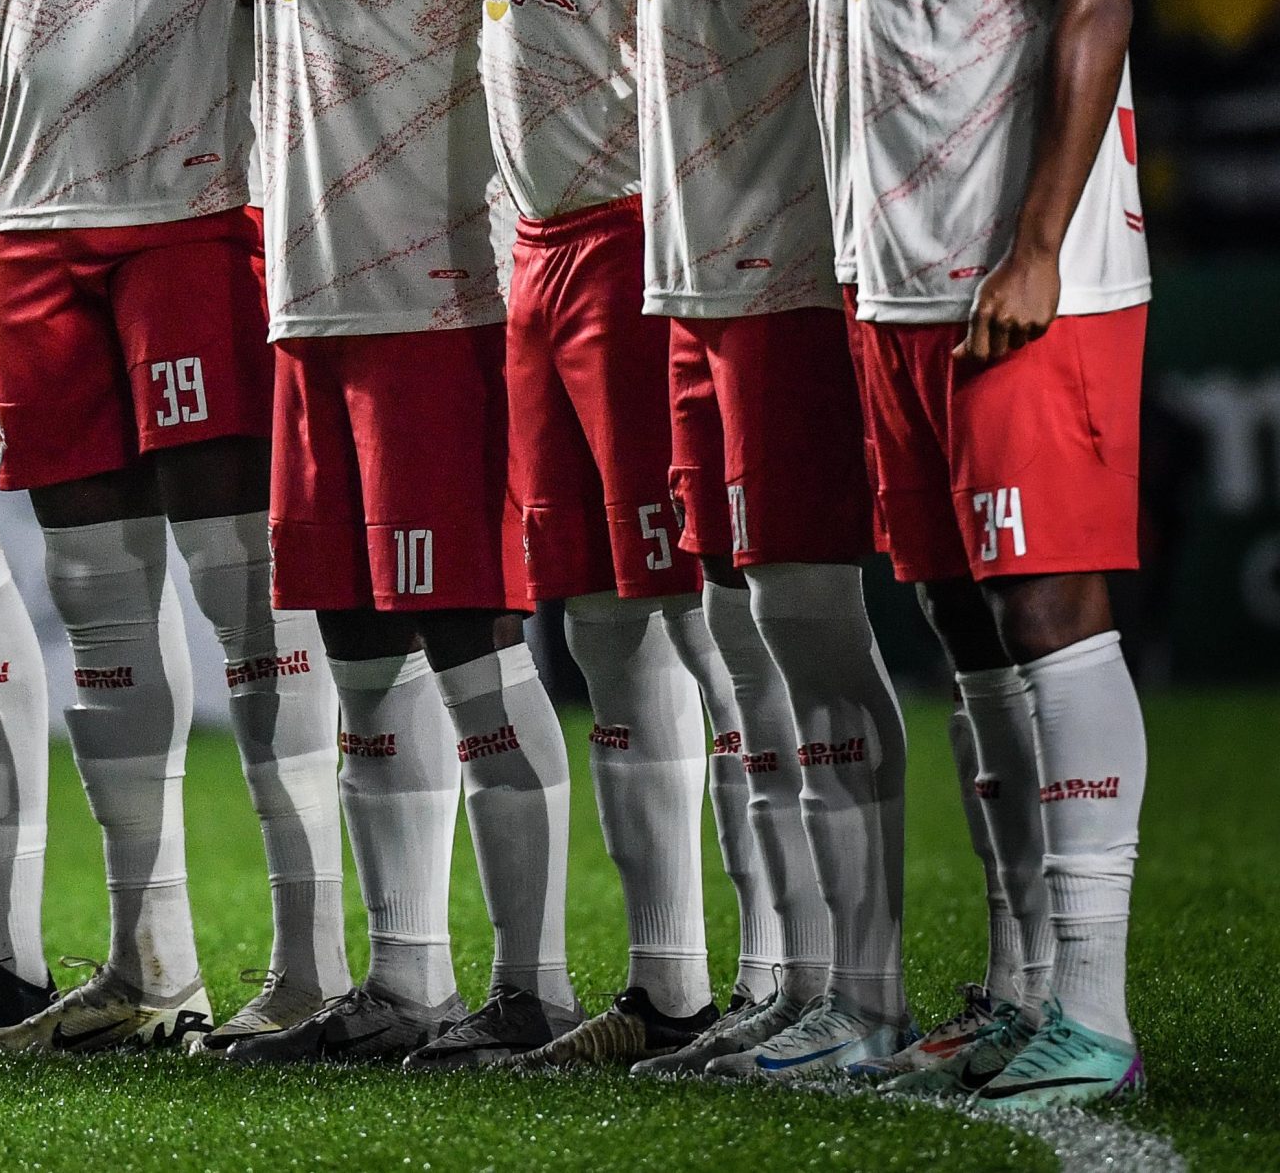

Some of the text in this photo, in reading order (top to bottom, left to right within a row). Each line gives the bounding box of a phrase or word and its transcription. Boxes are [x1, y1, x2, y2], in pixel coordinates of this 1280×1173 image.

[151, 357, 208, 427] 39
[638, 503, 672, 570] 5
[973, 487, 1027, 561] 34
[394, 529, 433, 594] 10
[256, 650, 308, 669] Bull
[466, 725, 517, 749] Bull
[811, 738, 864, 755] Bull
[1066, 777, 1119, 791] Bull
